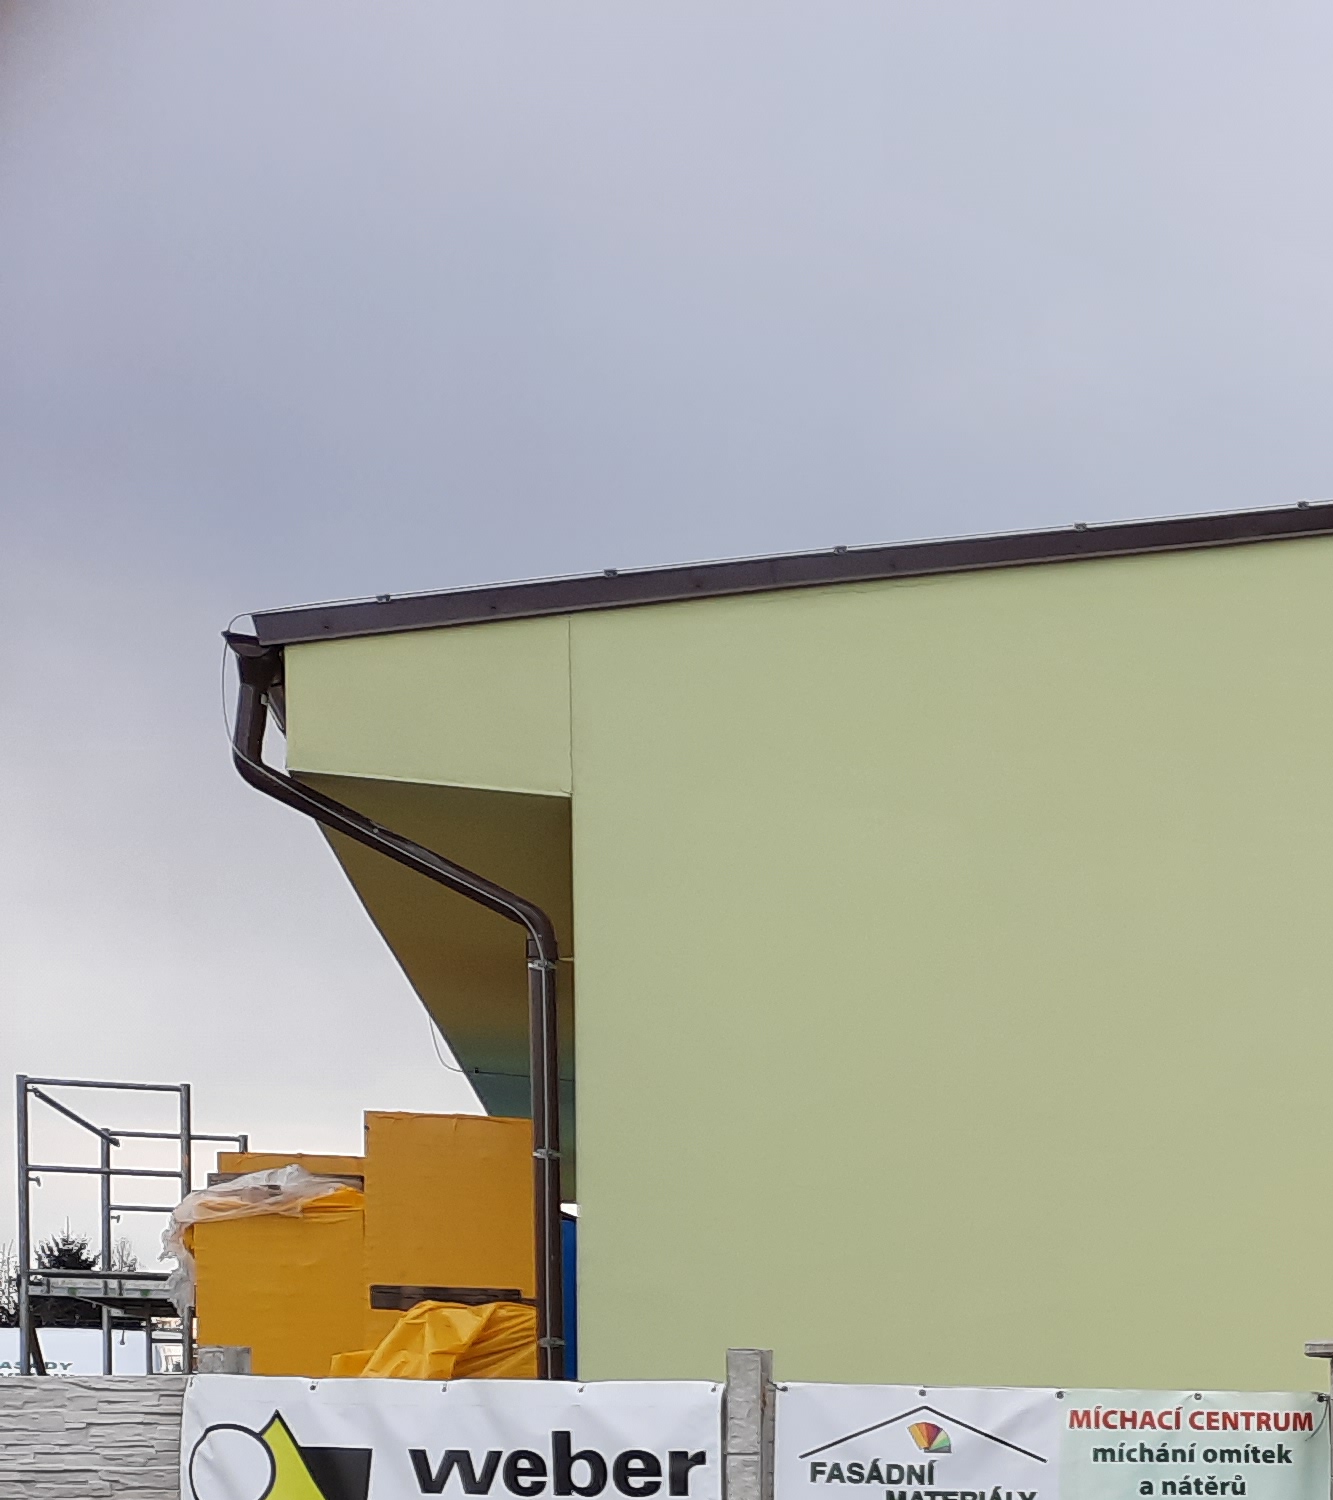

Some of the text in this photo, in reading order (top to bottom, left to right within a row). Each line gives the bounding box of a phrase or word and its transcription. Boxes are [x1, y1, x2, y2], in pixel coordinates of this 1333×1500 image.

[1069, 1406, 1313, 1432] MÍCHACÍ CENTRUM
[408, 1430, 707, 1497] weber
[1092, 1443, 1293, 1464] míchání omítek
[810, 1458, 938, 1485] FASÁDNÍ
[1140, 1475, 1246, 1496] a nátěrů
